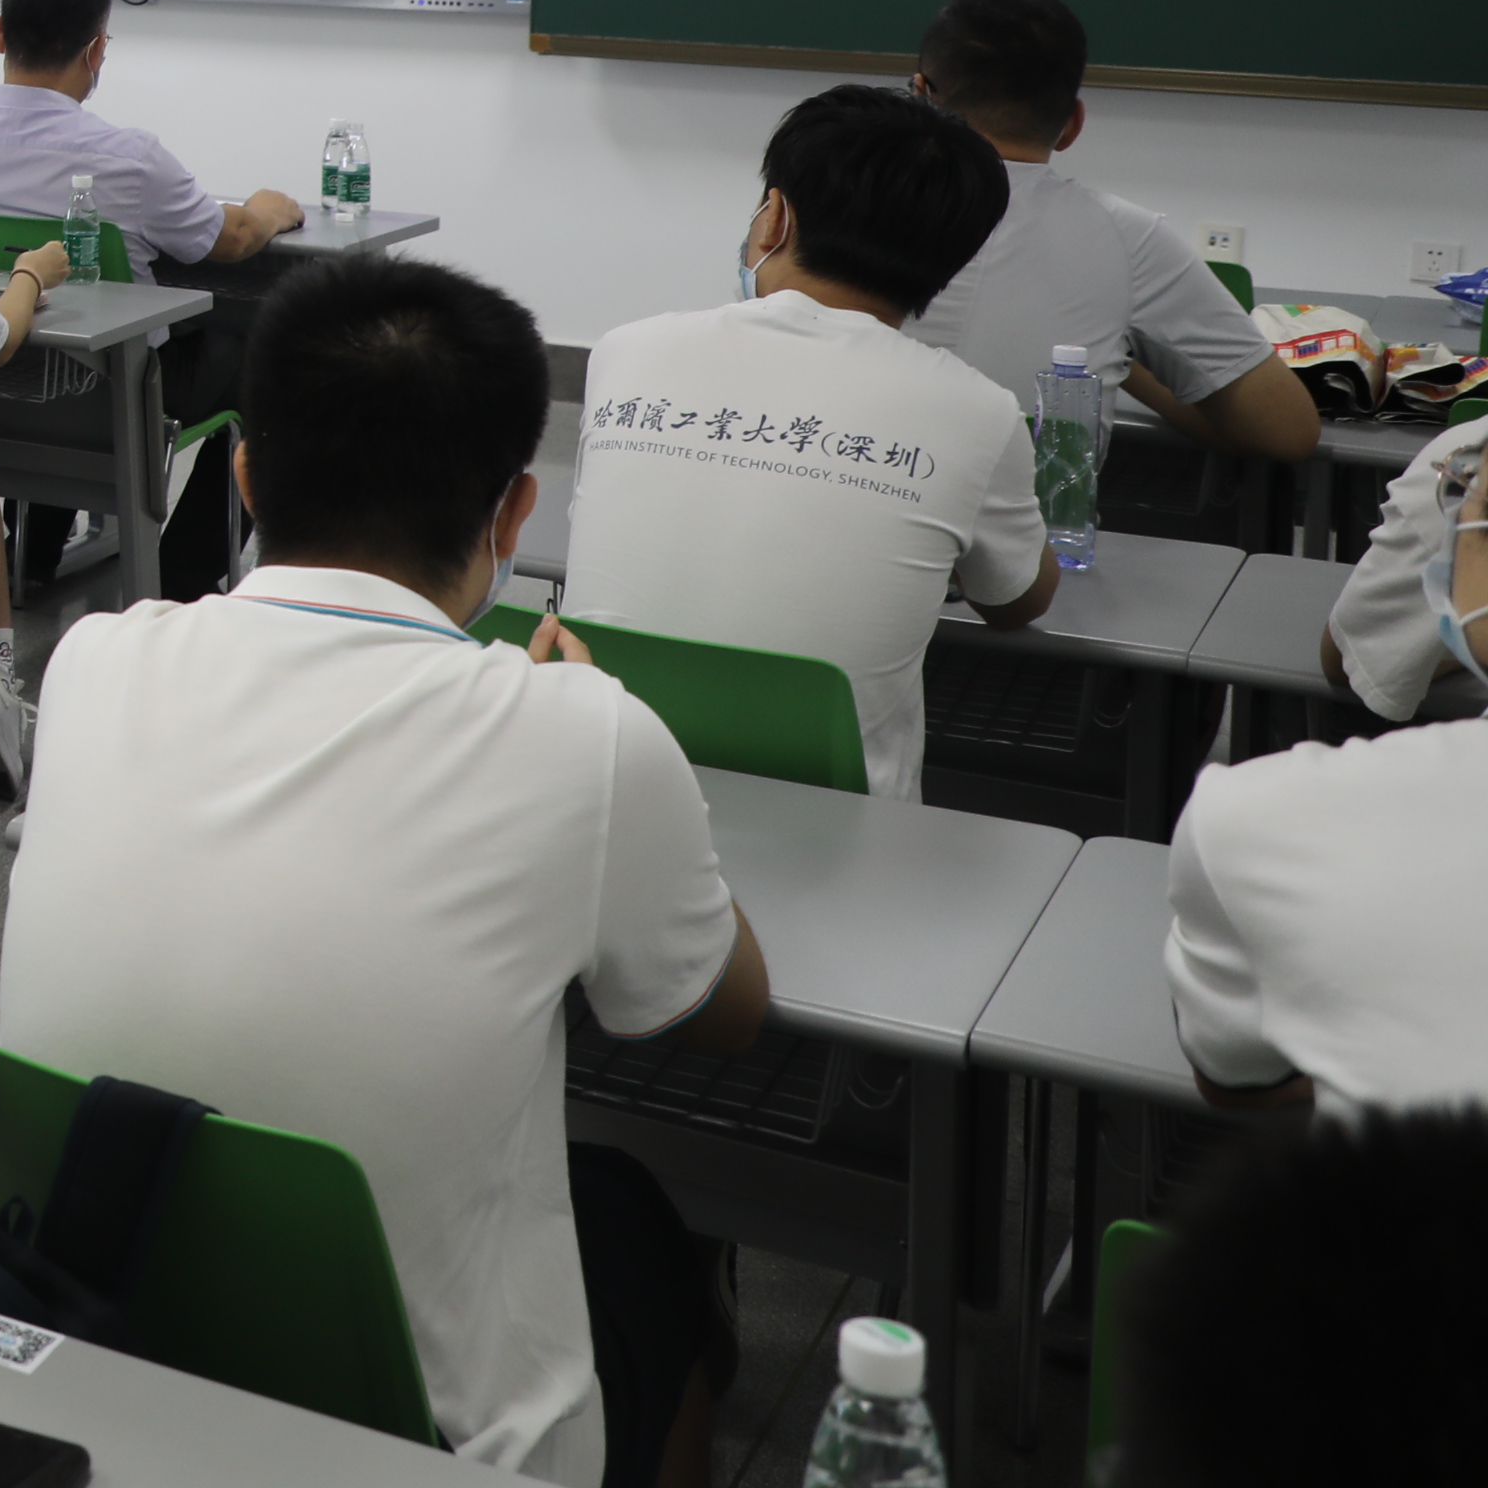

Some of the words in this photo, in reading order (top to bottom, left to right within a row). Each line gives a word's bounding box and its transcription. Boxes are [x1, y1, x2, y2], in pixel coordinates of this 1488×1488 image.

[589, 439, 624, 452] HARBIN
[624, 440, 693, 460] INSTITUTE
[696, 451, 718, 463] OF
[837, 473, 922, 504] SHENZHEN
